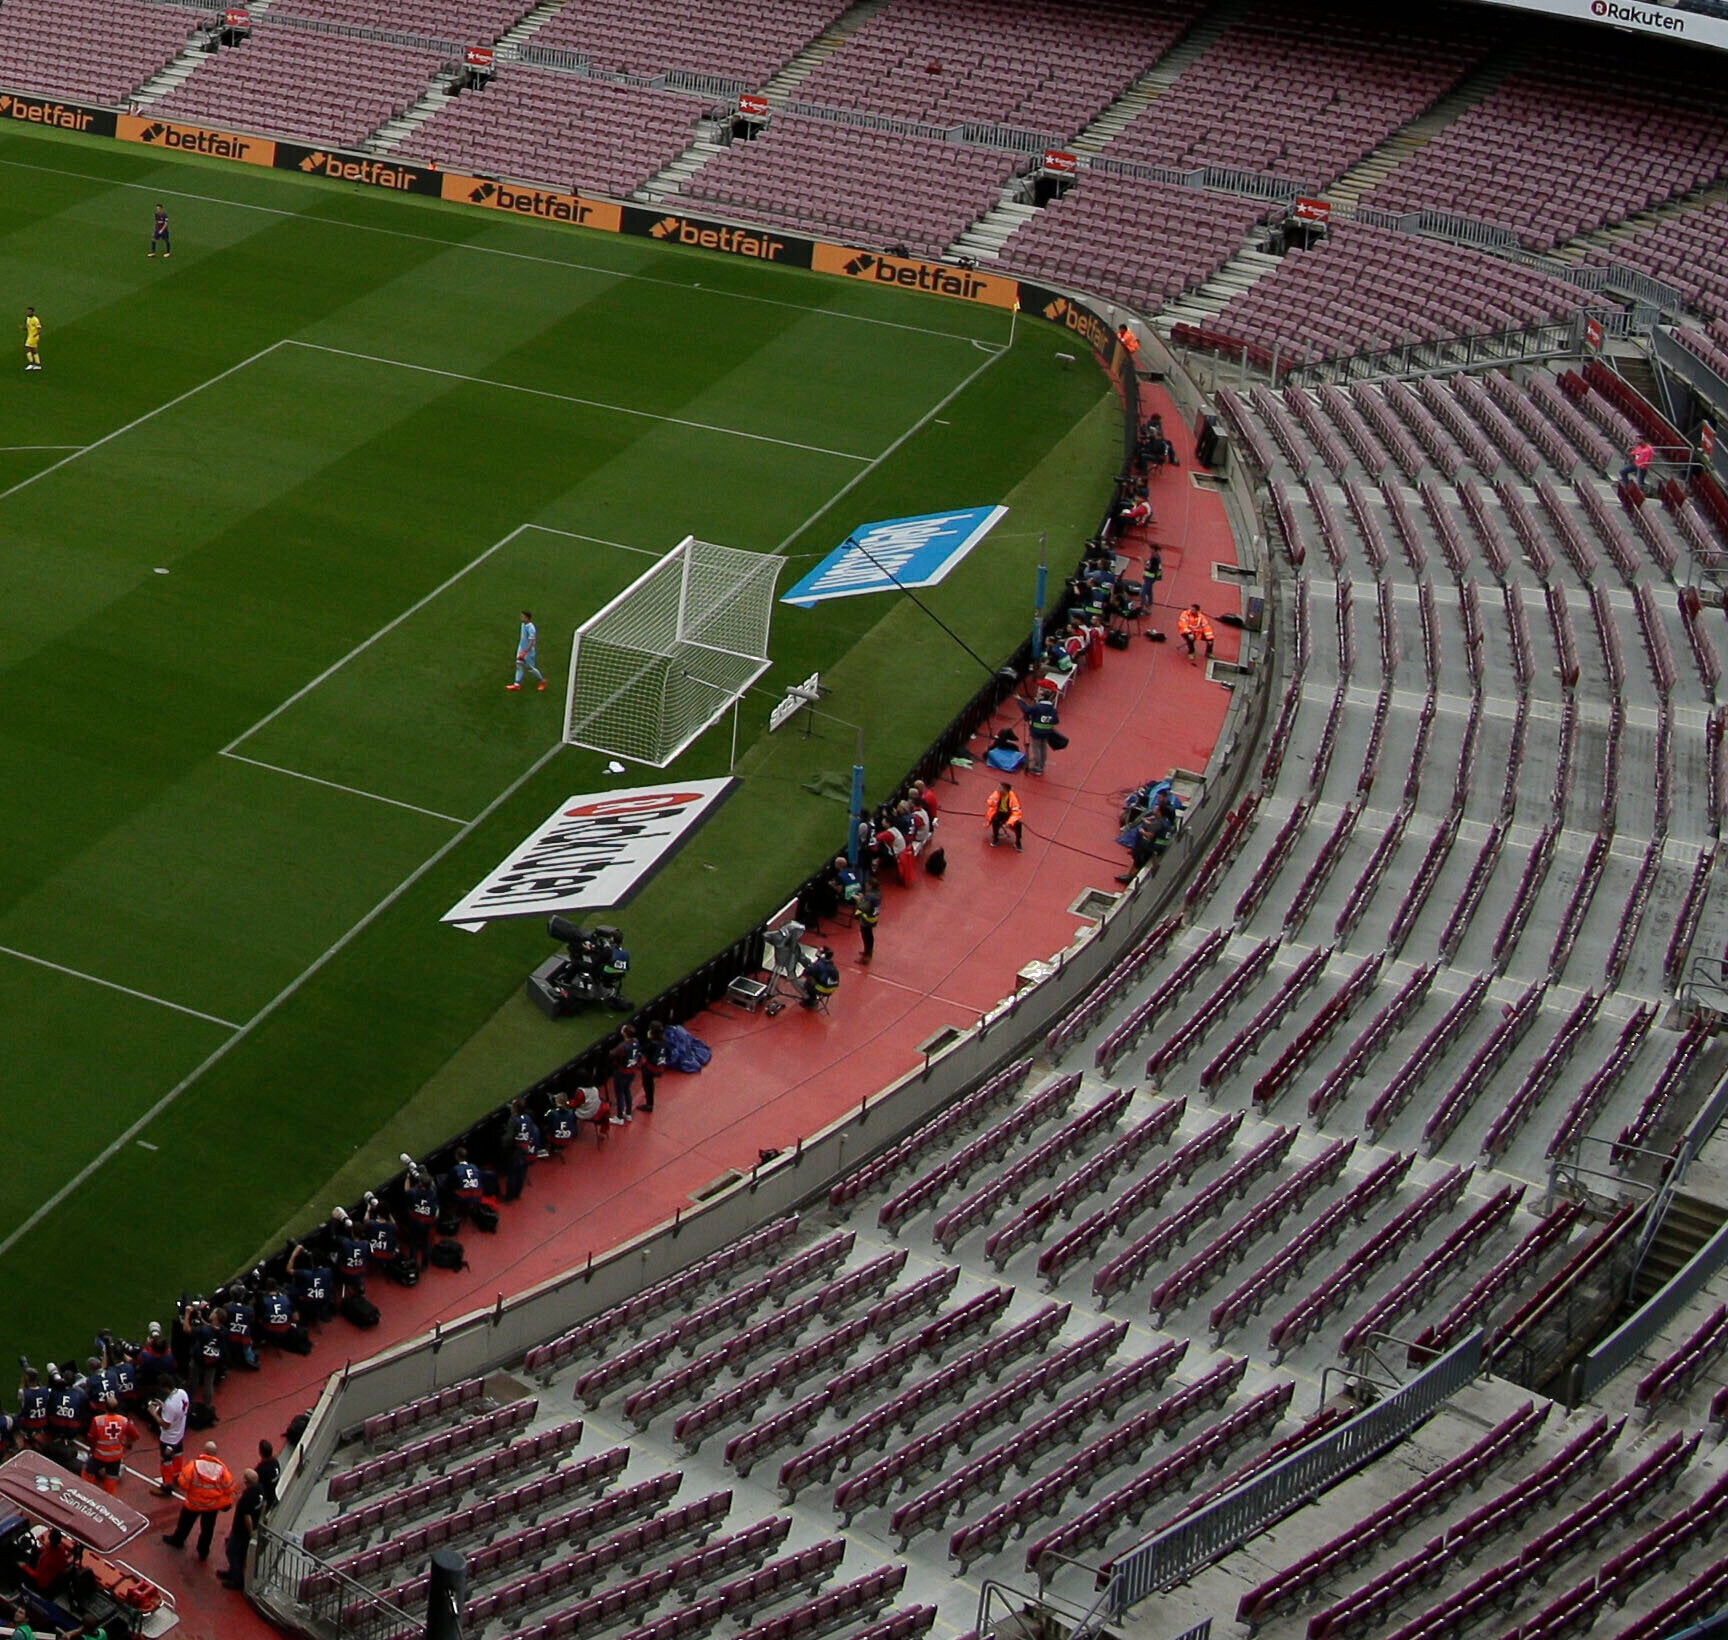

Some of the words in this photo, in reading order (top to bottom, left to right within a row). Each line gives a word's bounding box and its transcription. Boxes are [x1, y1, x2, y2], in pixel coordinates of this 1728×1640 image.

[1609, 2, 1684, 31] Rakuten
[13, 100, 91, 132] betfair
[168, 129, 248, 160] betfair
[326, 157, 416, 191] betfair
[496, 188, 592, 224] betfair
[680, 221, 783, 261] betfair
[875, 260, 986, 301] betfair
